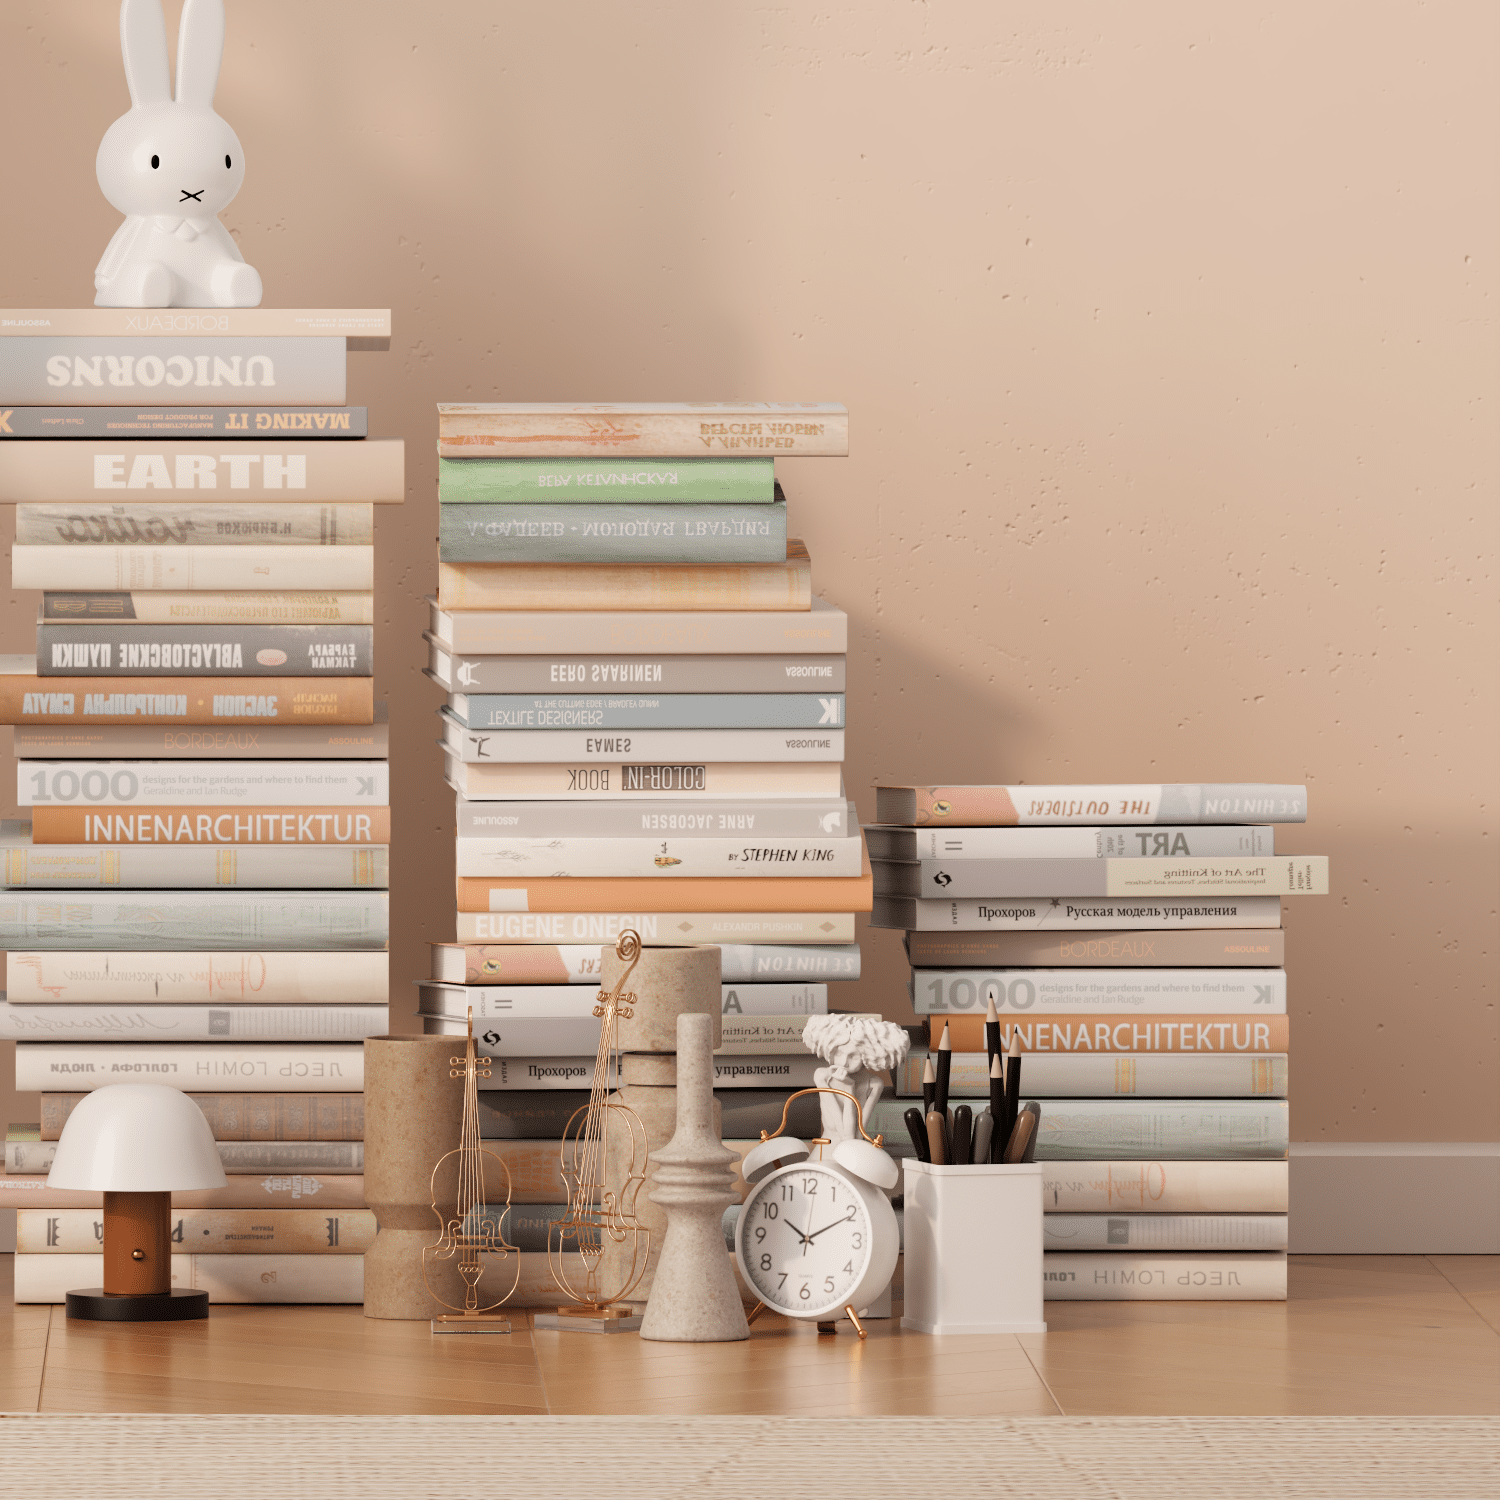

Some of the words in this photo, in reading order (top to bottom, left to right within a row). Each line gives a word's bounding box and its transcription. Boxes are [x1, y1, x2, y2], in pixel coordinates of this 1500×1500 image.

[46, 355, 276, 387] UNICORNS
[226, 413, 249, 429] IT
[256, 413, 350, 429] MAKING
[94, 455, 306, 488] EARTH
[164, 733, 260, 749] BORDEAUX
[31, 770, 138, 801] 1000
[142, 774, 177, 786] designs
[178, 774, 191, 784] for
[192, 774, 206, 784] the
[207, 774, 244, 786] gardens
[245, 774, 263, 784] and
[264, 774, 292, 784] where
[294, 775, 303, 784] to
[304, 774, 321, 784] find
[323, 774, 347, 784] them
[567, 770, 609, 790] BOOK
[143, 786, 181, 796] Geraldine
[184, 786, 202, 796] and
[205, 786, 218, 796] Ian
[221, 786, 247, 798] Rudge
[1028, 799, 1108, 817] OUTSIDERS
[1119, 800, 1151, 816] THE
[1205, 798, 1275, 815] HINTON
[85, 815, 371, 841] INNENARCHITEKTUR
[473, 816, 519, 825] ASSOULINE
[641, 814, 713, 829] JACOBSEN
[719, 814, 755, 829] ARNE
[728, 853, 738, 861] BY
[741, 848, 797, 862] STEPHEN
[802, 849, 834, 862] KING
[978, 906, 1036, 920] Прохоров
[1066, 905, 1114, 919] Русская
[1117, 905, 1160, 919] модель
[1164, 904, 1237, 919] управления
[475, 915, 564, 939] EUGENE
[573, 915, 658, 939] ONEGIN
[712, 922, 759, 932] ALEXANDR
[762, 922, 803, 932] PUSHKIN
[1060, 941, 1156, 958] BORDEAUX
[1224, 945, 1270, 954] ASSOULINE
[757, 957, 828, 973] HINTON
[927, 979, 1036, 1009] 1000
[1039, 982, 1074, 995] designs
[1075, 982, 1088, 992] for
[1089, 982, 1103, 992] the
[1104, 982, 1141, 995] gardens
[1142, 982, 1160, 992] and
[1161, 982, 1189, 992] where
[1191, 983, 1200, 992] to
[1201, 982, 1218, 992] find
[1220, 982, 1244, 992] them
[1040, 994, 1079, 1004] Geraldine
[1082, 994, 1099, 1004] and
[1102, 994, 1115, 1004] Ian
[1118, 994, 1145, 1006] Rudge
[528, 1064, 587, 1078] Прохоров
[715, 1063, 790, 1078] управления
[782, 1185, 793, 1201] 11
[802, 1178, 818, 1194] 12
[831, 1187, 836, 1202] 1
[763, 1202, 778, 1220] 10
[846, 1205, 856, 1221] 2
[756, 1227, 766, 1244] 9
[852, 1233, 862, 1249] 3
[761, 1254, 771, 1271] 8
[843, 1260, 853, 1275] 4
[262, 1271, 276, 1284] 2
[778, 1273, 788, 1290] 7
[824, 1276, 834, 1293] 5
[799, 1283, 810, 1299] 6
